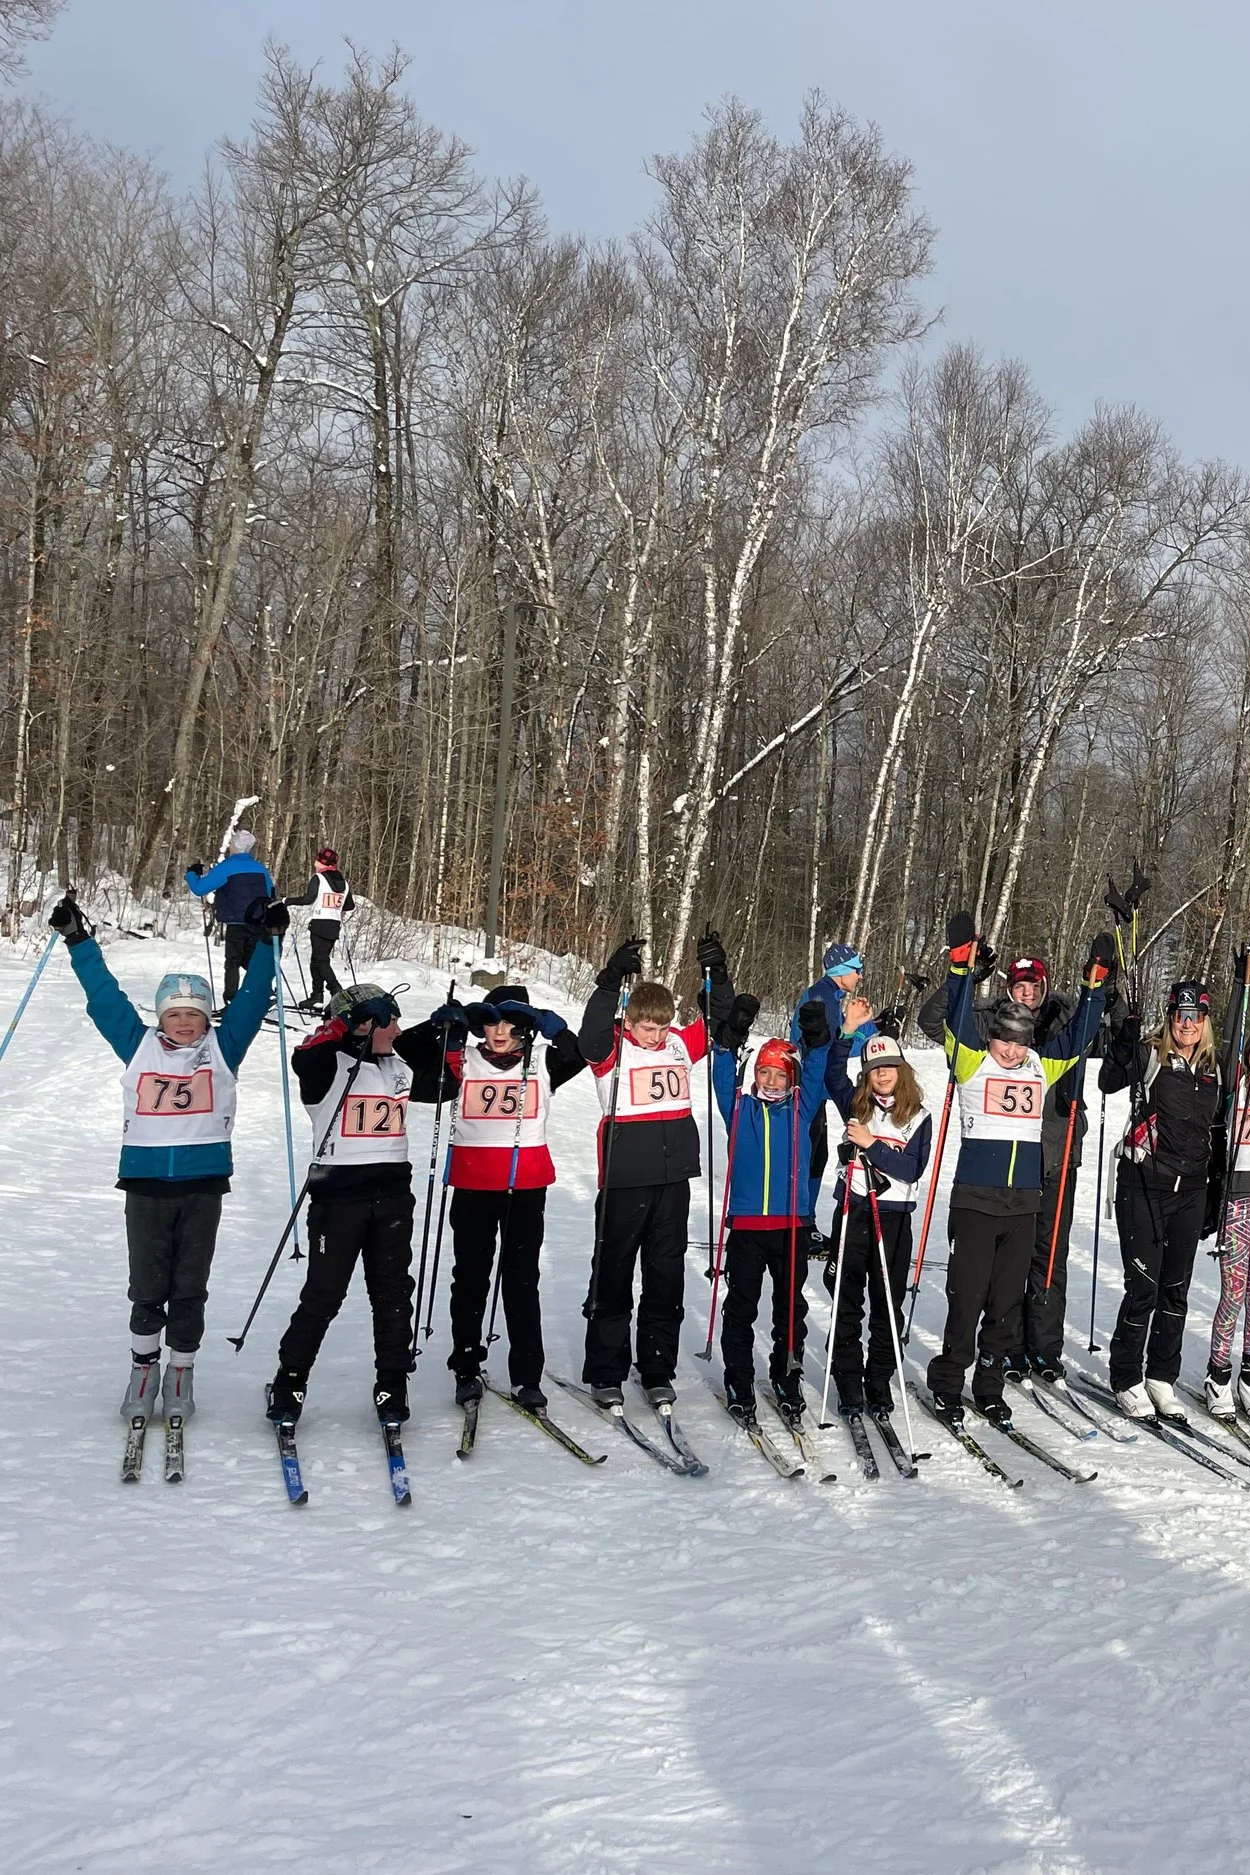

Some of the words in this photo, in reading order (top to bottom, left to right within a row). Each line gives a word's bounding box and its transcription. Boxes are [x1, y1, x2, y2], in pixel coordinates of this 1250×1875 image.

[870, 1043, 886, 1053] CN
[152, 1079, 193, 1111] 75
[481, 1084, 519, 1116] 95
[648, 1068, 681, 1101] 50
[1001, 1084, 1034, 1114] 53
[224, 1116, 230, 1129] 7
[352, 1099, 406, 1133] 121
